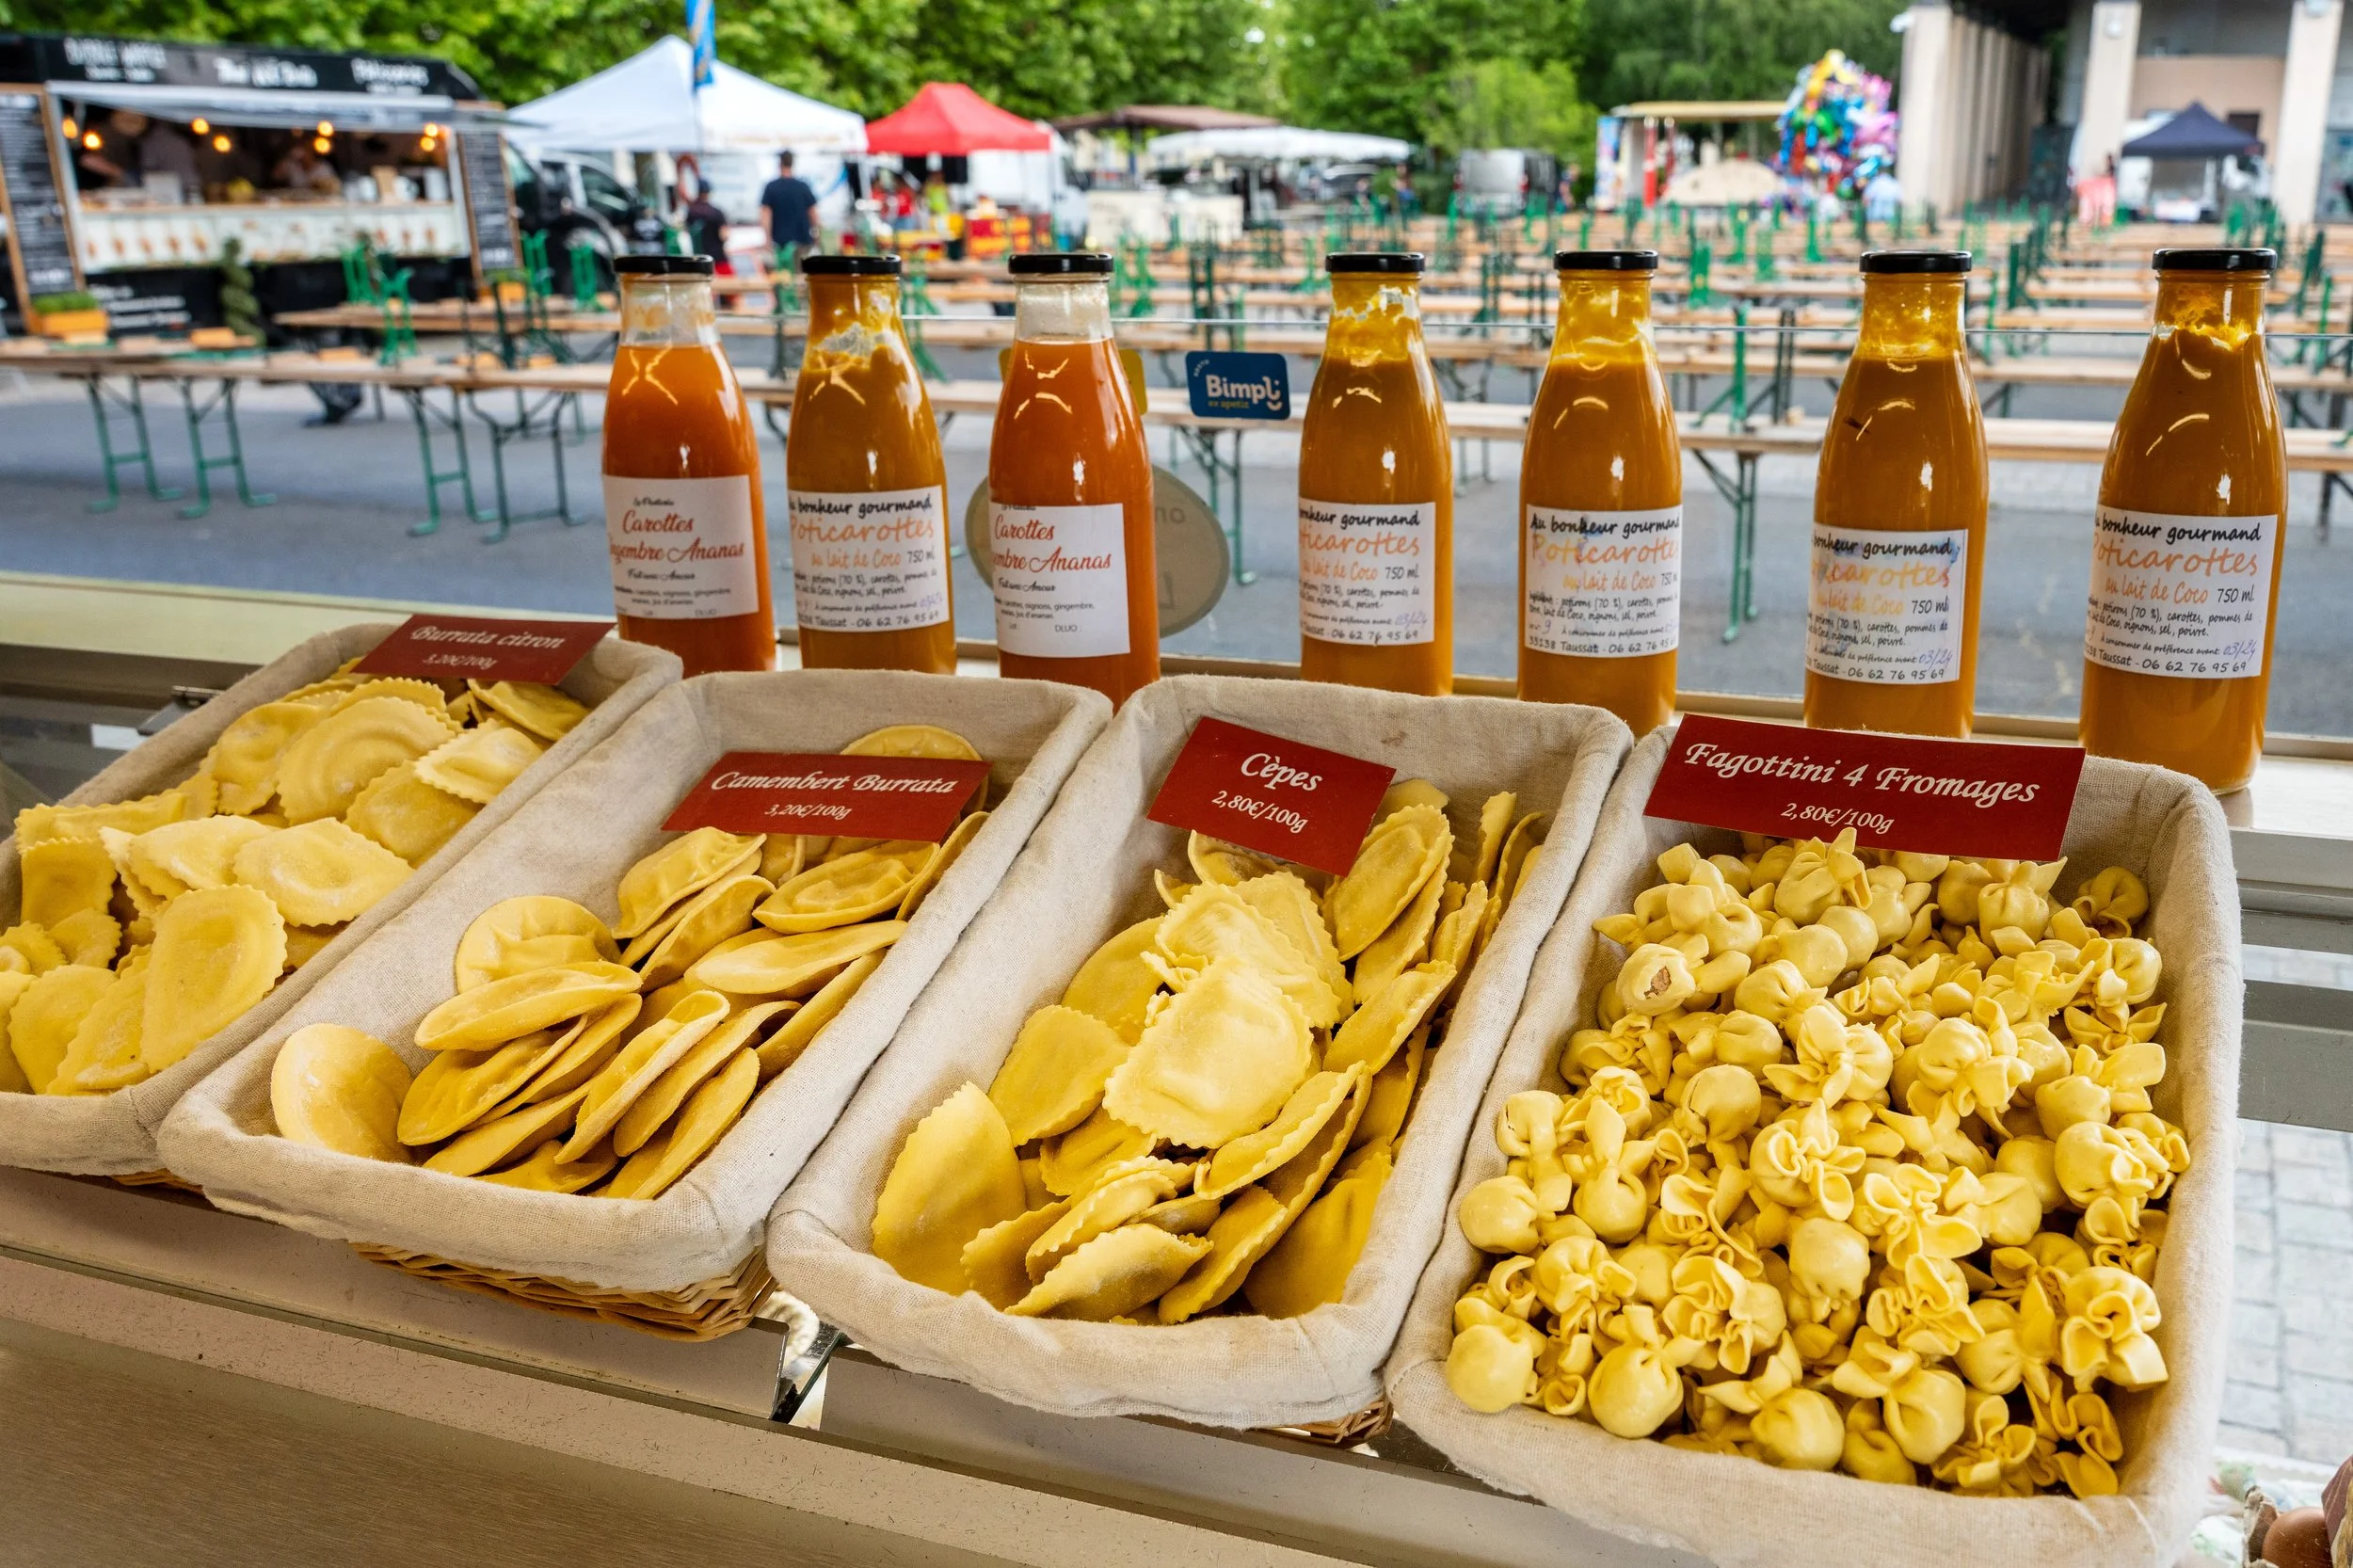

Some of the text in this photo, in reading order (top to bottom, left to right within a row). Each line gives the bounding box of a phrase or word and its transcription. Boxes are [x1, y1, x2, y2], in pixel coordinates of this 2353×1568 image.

[1206, 375, 1281, 404] Bimpli
[798, 493, 932, 519] bonheur gourmand
[622, 509, 694, 535] Carottes
[995, 514, 1055, 540] Carottes
[1340, 509, 1420, 530] gourmand
[1529, 513, 1546, 529] Au
[1551, 516, 1618, 534] bonheur
[2103, 513, 2262, 545] bonheur gourmand
[666, 537, 744, 563] Ananas
[907, 550, 924, 564] 750
[1029, 546, 1112, 573] Ananas
[1863, 536, 1952, 560] gourmand
[1385, 566, 1405, 580] 750
[2121, 574, 2147, 600] lait
[2150, 576, 2169, 600] de
[2173, 580, 2209, 605] Coco
[2217, 587, 2239, 603] 750
[1911, 600, 1933, 614] 750
[2131, 605, 2146, 620] (70
[2167, 610, 2203, 625] carottes,
[2208, 613, 2241, 626] pommes
[2244, 612, 2253, 622] de
[856, 617, 872, 628] 06
[876, 616, 892, 627] 62
[1866, 621, 1899, 633] carottes,
[1904, 623, 1936, 635] pommes
[2105, 615, 2209, 638] Coco, oignons, sel, poivre.
[410, 625, 566, 649] Burrata citron
[1349, 630, 1363, 640] 62
[1560, 640, 1599, 654] Taussat
[1608, 644, 1625, 654] 06
[1628, 643, 1641, 653] 62
[1861, 635, 1875, 647] sel,
[1877, 634, 1906, 648] poivre.
[2099, 648, 2132, 666] Taussat
[2141, 658, 2160, 670] 06
[2165, 660, 2184, 672] 62
[2190, 662, 2207, 673] 76
[2212, 662, 2228, 673] 95
[2232, 661, 2247, 672] 69
[2142, 642, 2152, 651] de
[2153, 643, 2194, 655] préférence
[1814, 659, 1945, 680] Taussat 06 62 76 95 69
[711, 770, 958, 794] Camembert Burrata
[1241, 752, 1322, 792] Cèpes
[1684, 743, 2041, 808] Fagottini 4 Fromages
[764, 803, 853, 821] 3,20€/100g
[1212, 790, 1308, 834] 2,80€/100g
[1781, 802, 1895, 834] 2,80€/100g
